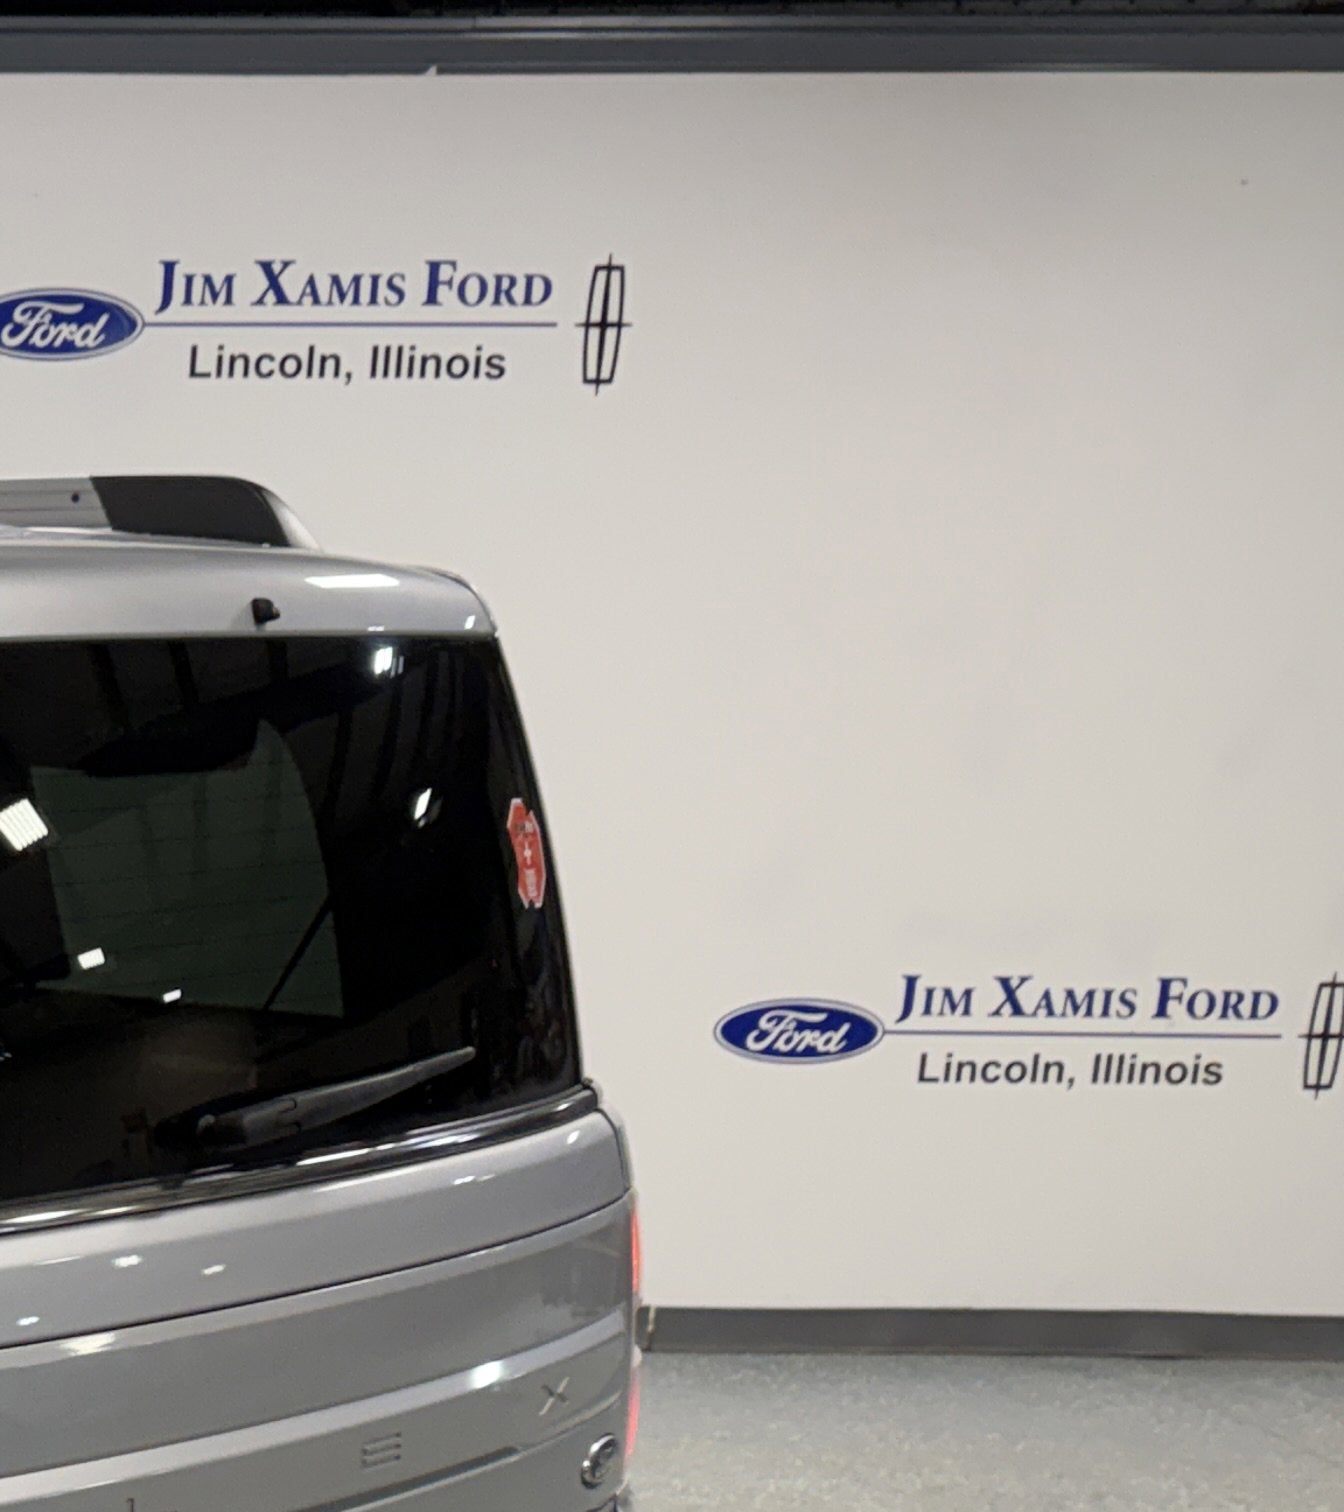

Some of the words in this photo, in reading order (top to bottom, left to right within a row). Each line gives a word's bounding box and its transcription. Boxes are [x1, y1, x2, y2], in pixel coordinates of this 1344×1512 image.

[154, 259, 236, 316] JIM
[250, 259, 407, 307] XAMIS
[421, 260, 554, 307] FORD
[188, 343, 353, 386] Lincoln,
[369, 344, 507, 381] Illinois
[894, 974, 975, 1025] JIM
[988, 975, 1138, 1019] XAMIS
[1150, 976, 1280, 1021] FORD
[916, 1051, 1076, 1090] Lincoln,
[1090, 1052, 1224, 1087] Illinois
